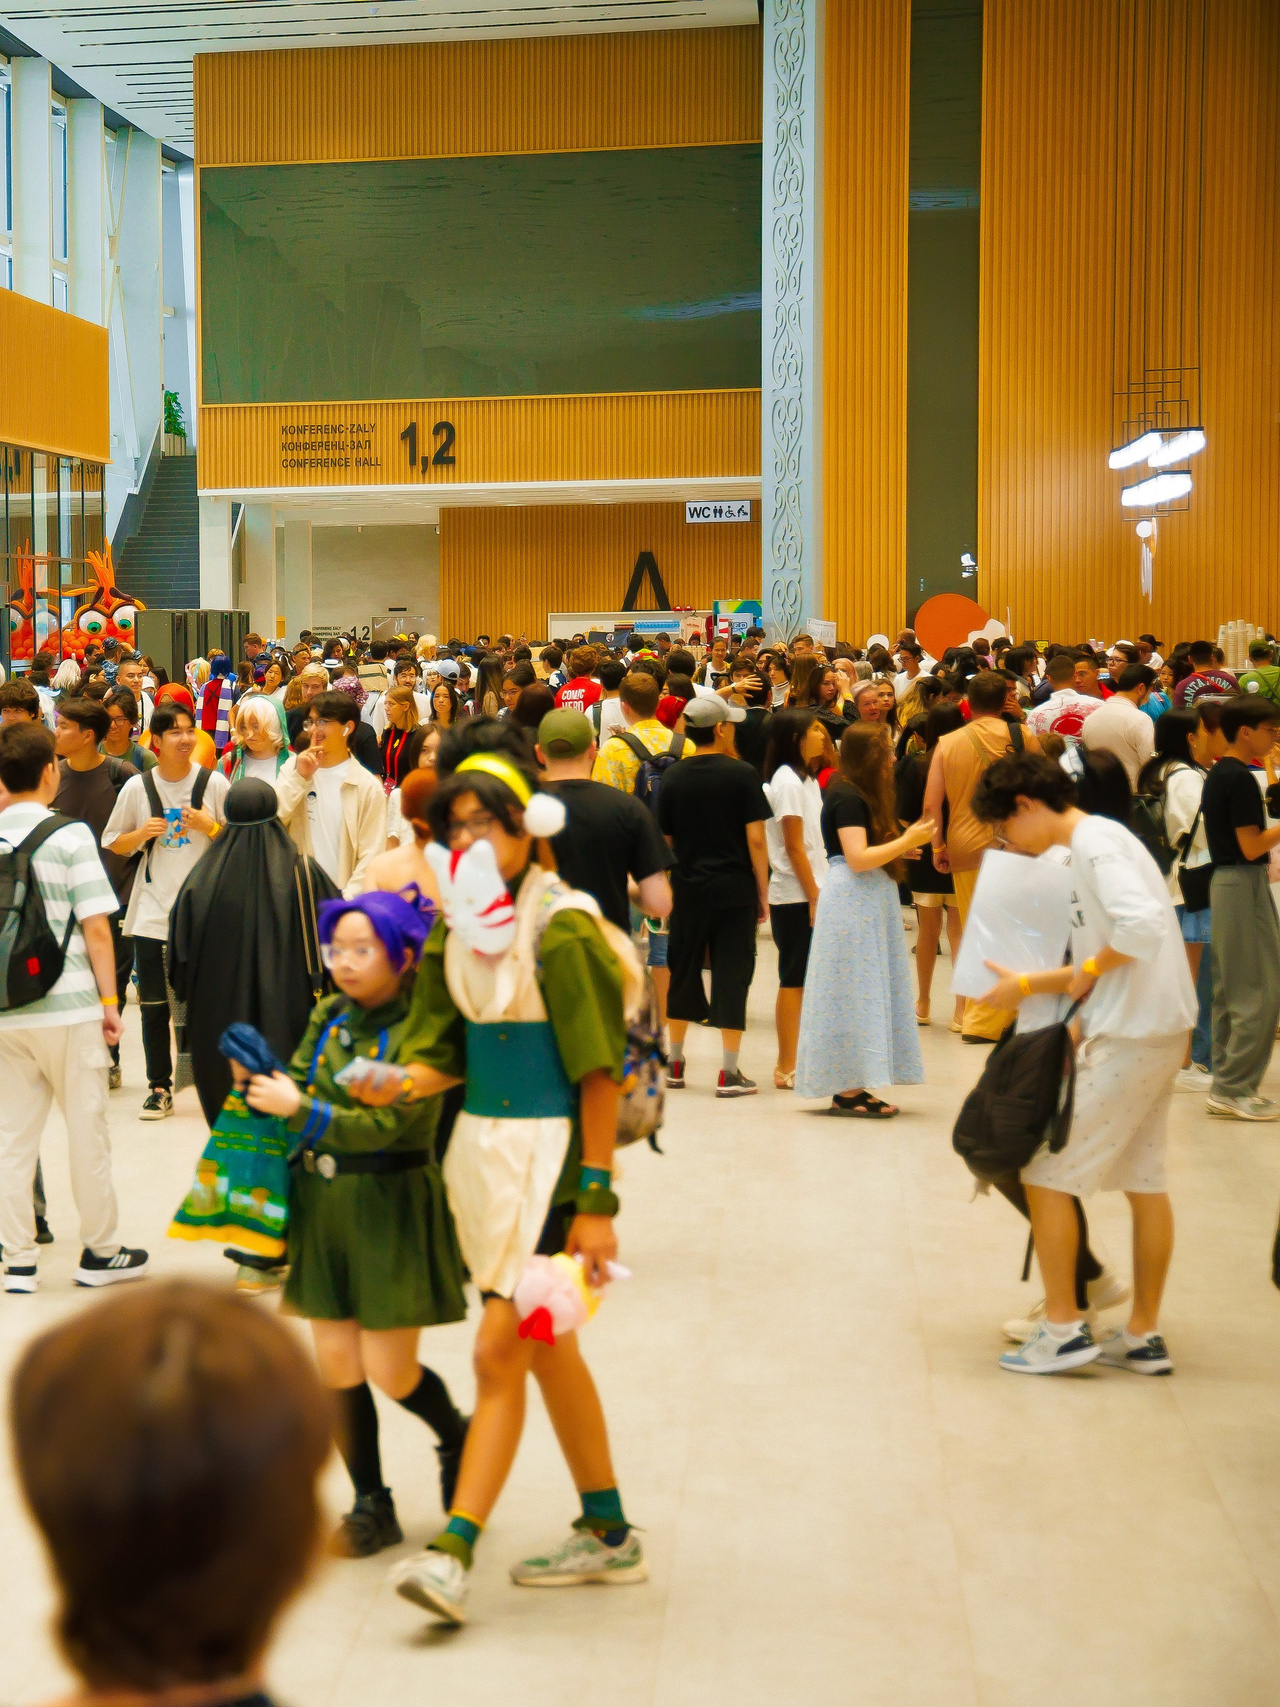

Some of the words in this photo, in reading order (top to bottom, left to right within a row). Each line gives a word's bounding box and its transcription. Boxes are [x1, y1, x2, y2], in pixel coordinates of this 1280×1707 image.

[281, 422, 377, 435] KONFERENC-ZALY
[281, 440, 371, 452] КОНФЕРЕНЦ-ЗАЛ
[400, 420, 456, 475] 1,2
[282, 457, 351, 469] CONFERENCE
[355, 456, 382, 467] HALL
[688, 506, 711, 519] WC
